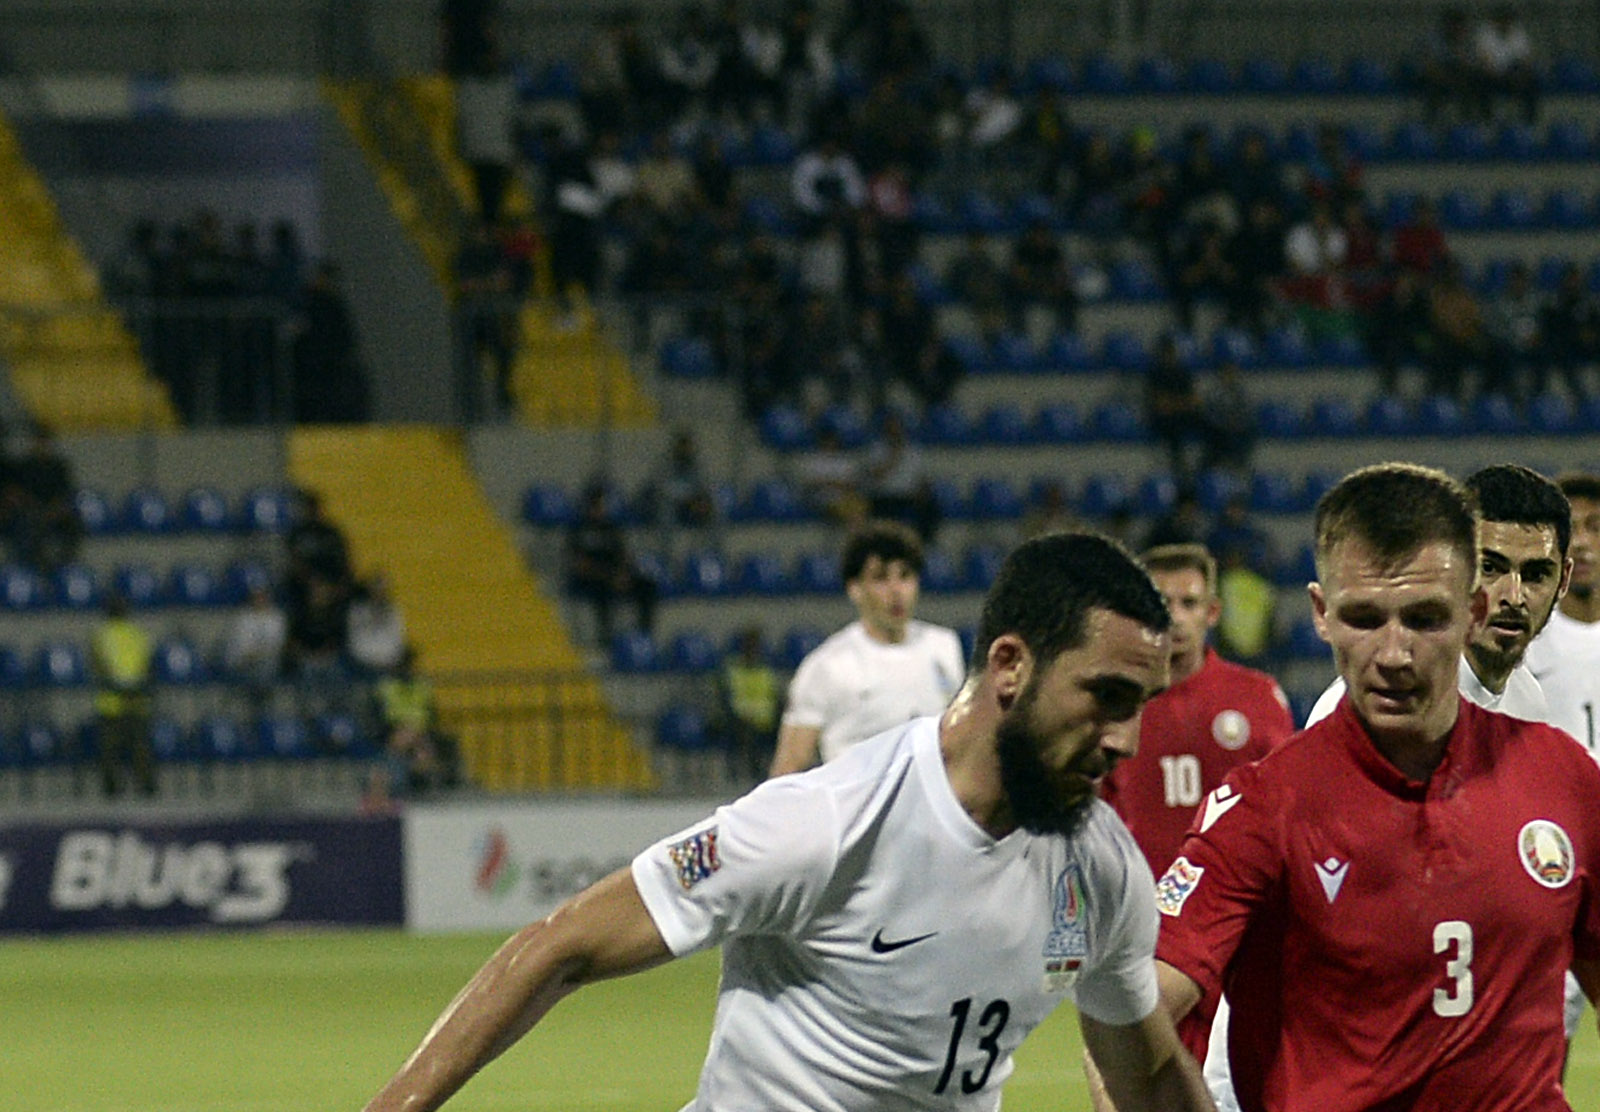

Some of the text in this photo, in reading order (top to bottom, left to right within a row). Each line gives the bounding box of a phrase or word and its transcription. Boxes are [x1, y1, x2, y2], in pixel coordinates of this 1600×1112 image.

[1160, 756, 1203, 808] 10
[1433, 921, 1474, 1018] 3
[934, 998, 1011, 1095] 13
